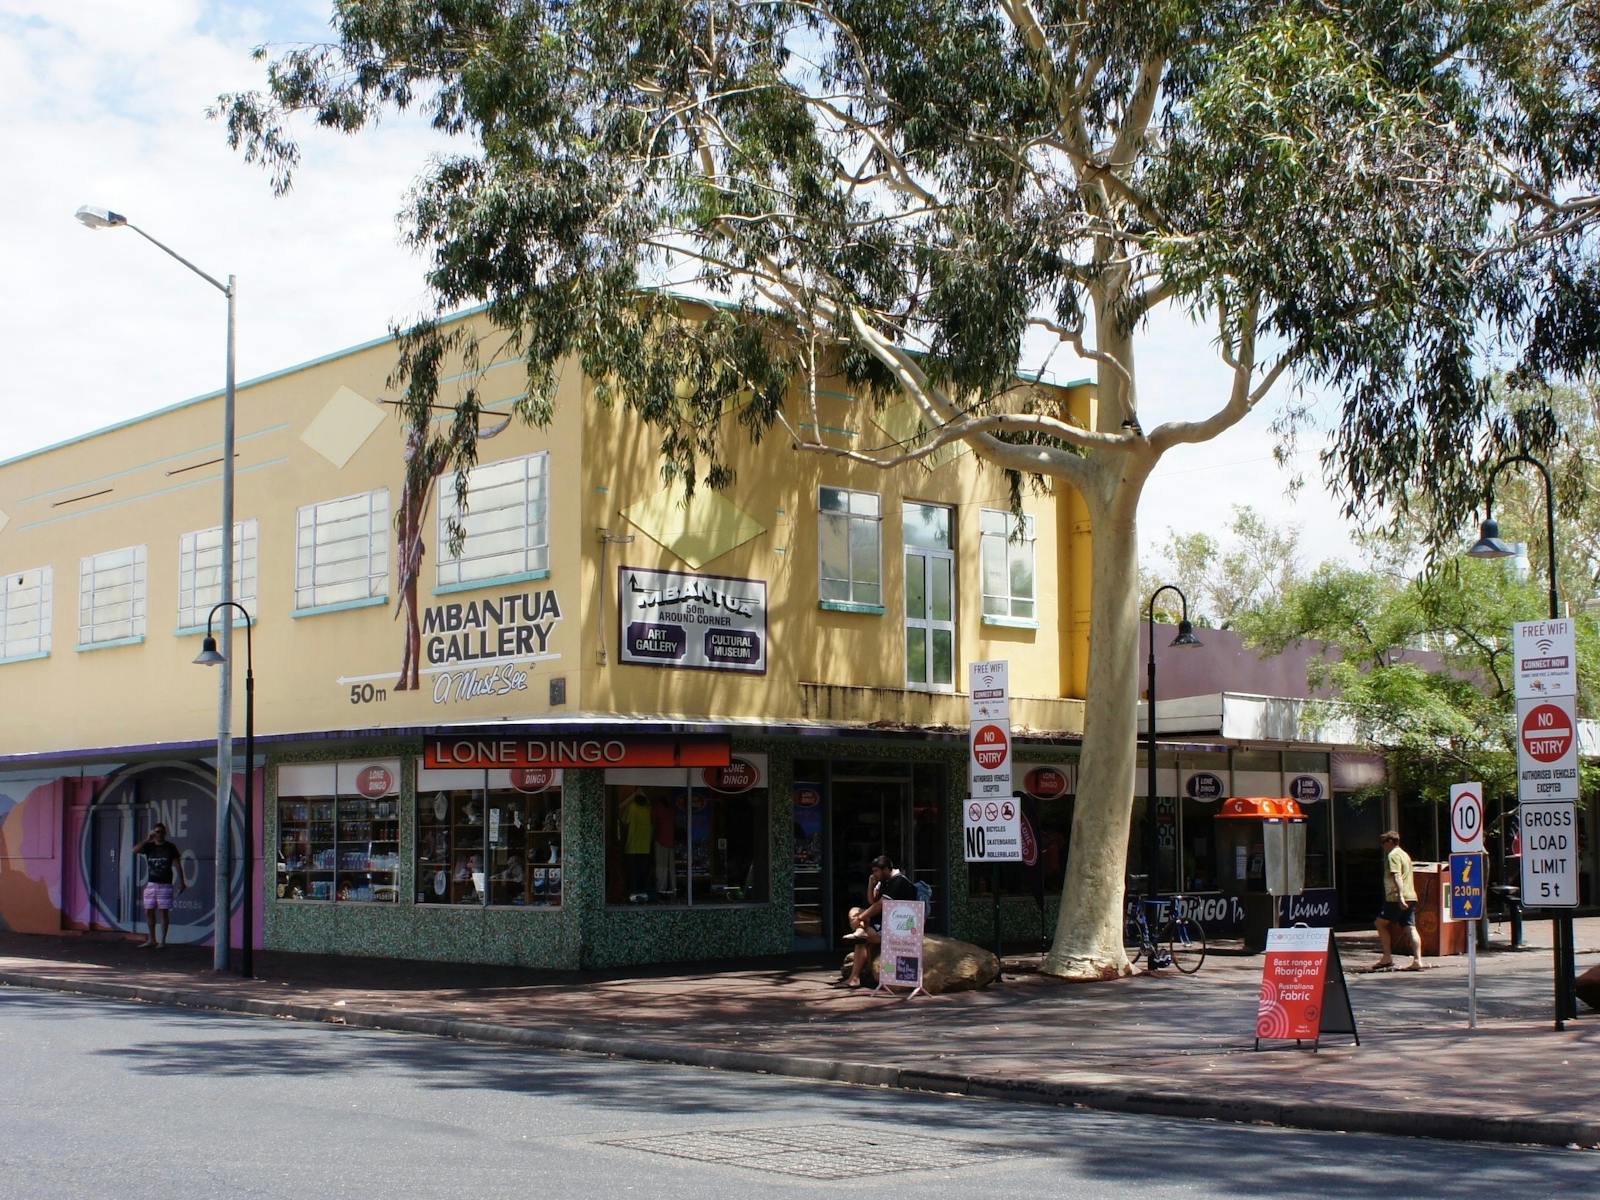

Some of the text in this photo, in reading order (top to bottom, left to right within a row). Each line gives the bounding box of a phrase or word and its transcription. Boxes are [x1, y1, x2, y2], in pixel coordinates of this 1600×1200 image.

[638, 580, 753, 619] MBANTUA
[422, 589, 562, 635] MBANTUA
[686, 604, 705, 615] 50m
[658, 611, 732, 627] AROUND CORNER
[647, 628, 667, 641] ART
[1522, 622, 1568, 638] FREE WIFI
[427, 621, 555, 665] GALLERY
[635, 640, 678, 654] GALLERY
[711, 634, 753, 648] CULTURAL
[713, 645, 750, 659] MUSEUM
[974, 663, 1004, 675] FREE WIFI
[1523, 658, 1566, 670] CONNECT NOW
[455, 668, 499, 701] Must
[350, 683, 387, 705] 50m
[1537, 712, 1554, 727] NO
[983, 731, 995, 743] NO
[436, 740, 626, 763] LONE DINGO
[1529, 738, 1564, 756] ENTRY
[978, 751, 1003, 765] ENTRY
[369, 769, 385, 780] LONE
[525, 774, 547, 785] DINGO
[723, 775, 749, 786] DINGO
[1521, 767, 1577, 781] AUTHORISED VEHICLES
[368, 781, 387, 791] DINGO
[1536, 782, 1562, 793] EXCEPTED
[1459, 805, 1476, 830] 10
[1525, 811, 1572, 828] GROSS
[986, 825, 1006, 833] BICYCLES
[966, 826, 986, 858] NO
[986, 838, 1017, 846] SKATEBOARDS
[1529, 834, 1568, 851] LOAD
[1531, 858, 1568, 875] LIMIT
[1454, 885, 1481, 897] 230m
[1288, 896, 1330, 921] Leisure
[1273, 958, 1323, 968] Best range of
[1274, 966, 1319, 978] Aboriginal
[1279, 991, 1311, 1001] Fabric
